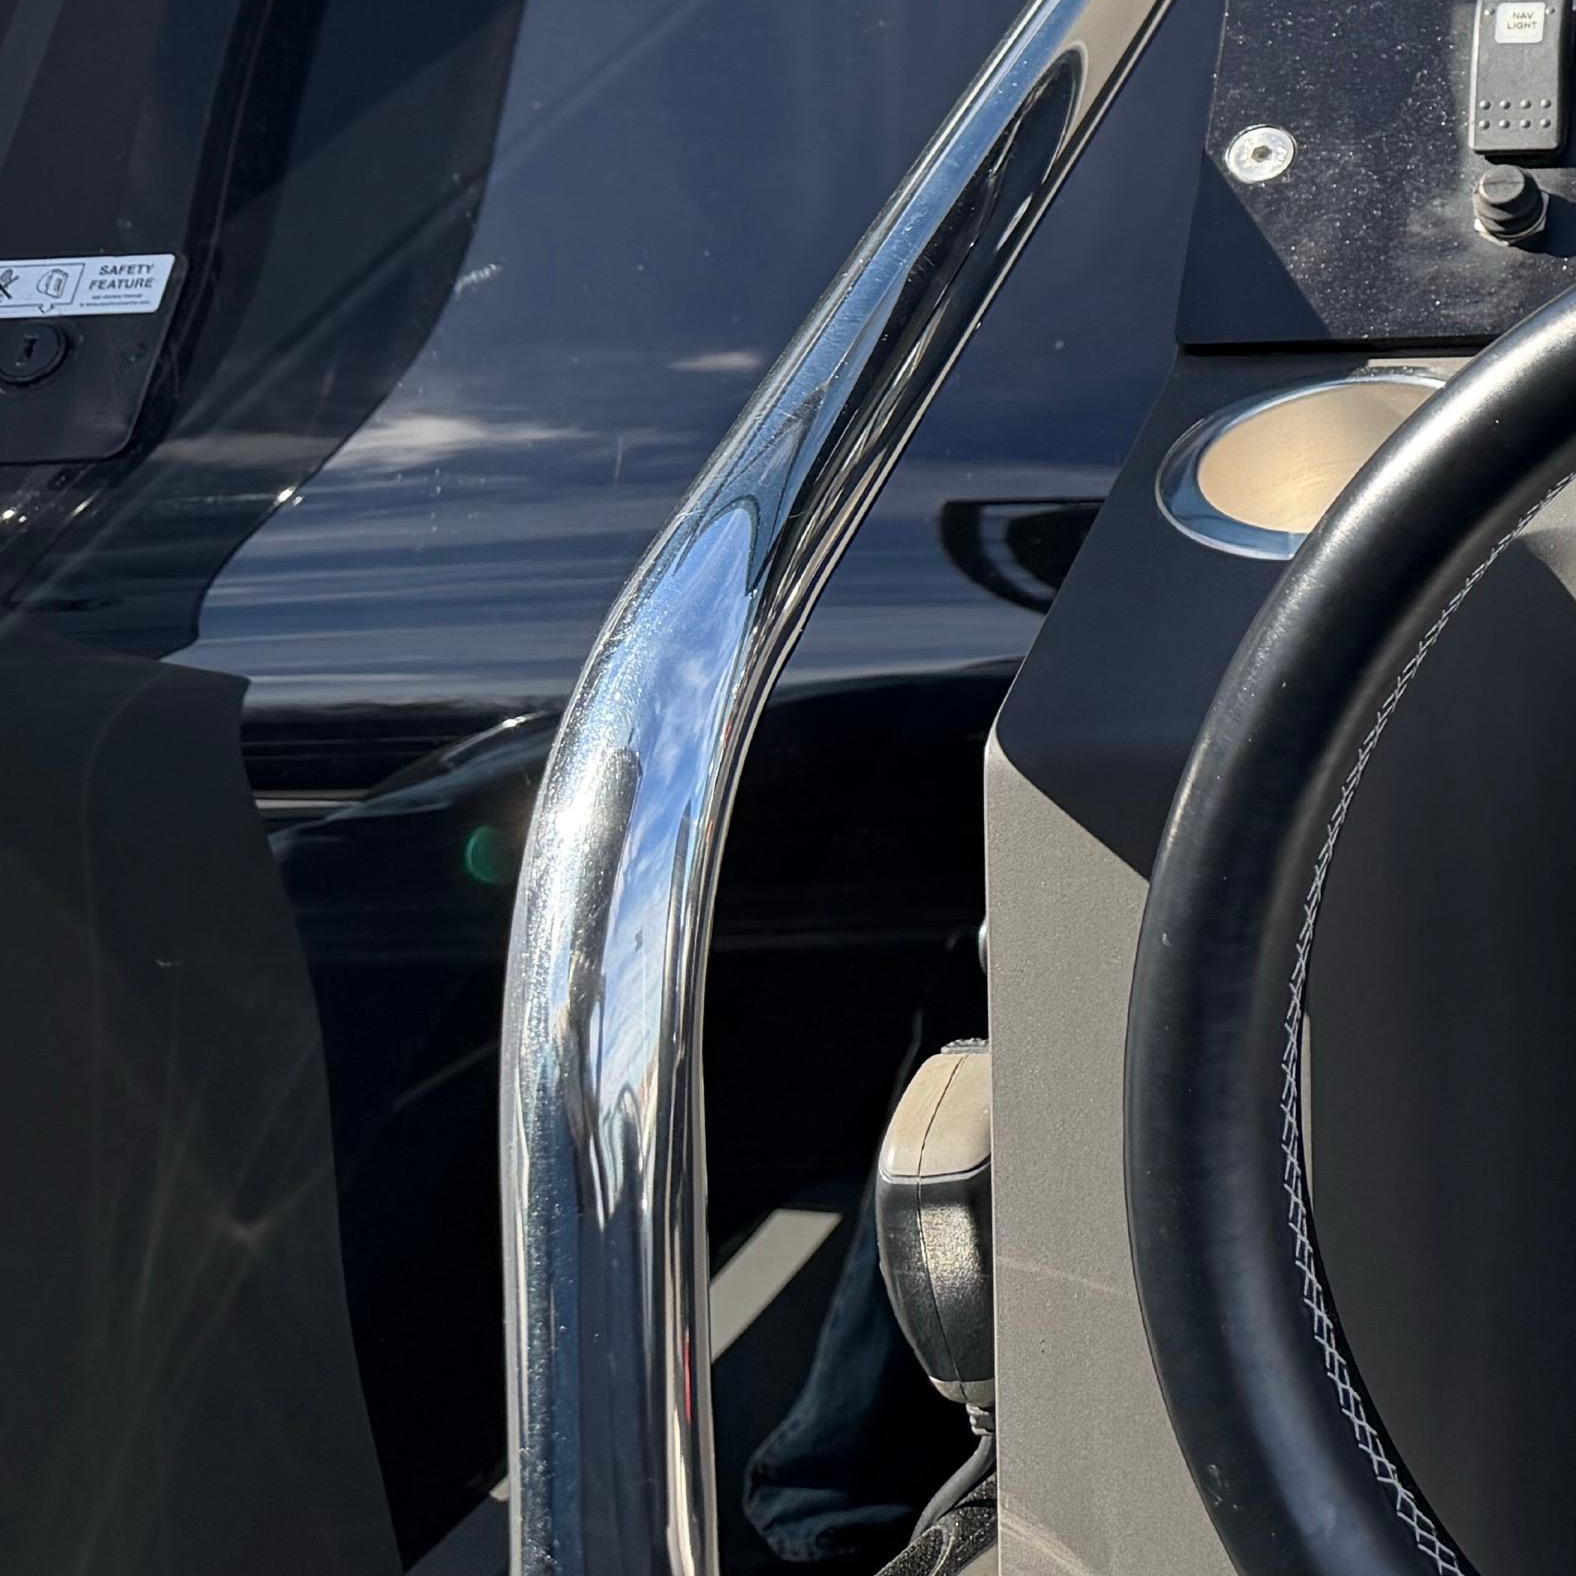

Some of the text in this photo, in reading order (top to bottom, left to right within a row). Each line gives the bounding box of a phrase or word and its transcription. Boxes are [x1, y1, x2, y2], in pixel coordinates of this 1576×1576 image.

[1512, 11, 1534, 20] NAV
[1507, 21, 1537, 30] LIGHT
[99, 263, 155, 276] SAFETY
[89, 276, 154, 291] FEATURE
